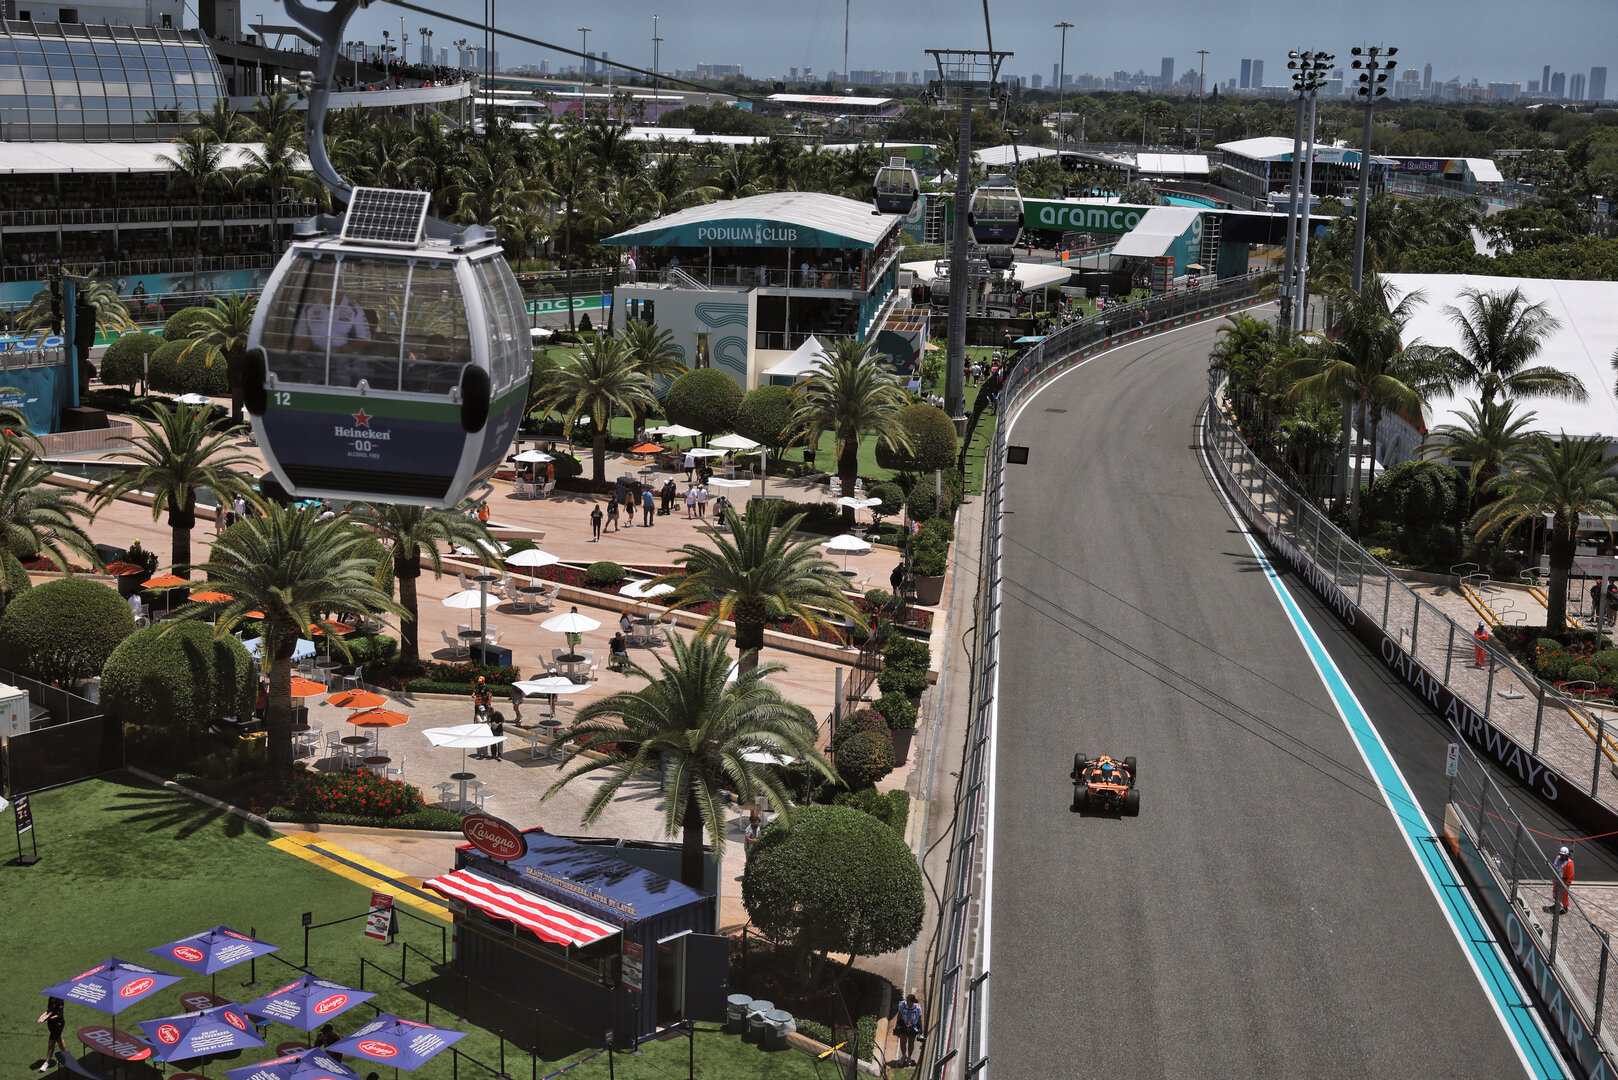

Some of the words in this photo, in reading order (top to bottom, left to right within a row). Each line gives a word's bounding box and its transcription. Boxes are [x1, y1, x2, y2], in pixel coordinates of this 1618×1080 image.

[1040, 206, 1140, 230] aramco
[1191, 215, 1203, 245] 9
[698, 227, 754, 241] PODIUM
[762, 227, 798, 241] CLUB
[274, 392, 291, 406] 12
[334, 426, 391, 440] Heineken
[1267, 525, 1302, 573] QATAR
[1303, 561, 1356, 626] AIRWAYS
[1381, 637, 1440, 709] QATAR
[1444, 697, 1558, 801] AIRWAYS
[468, 822, 516, 849] Lasagna
[1506, 912, 1583, 1064] QATAR
[84, 1029, 140, 1057] Barilla
